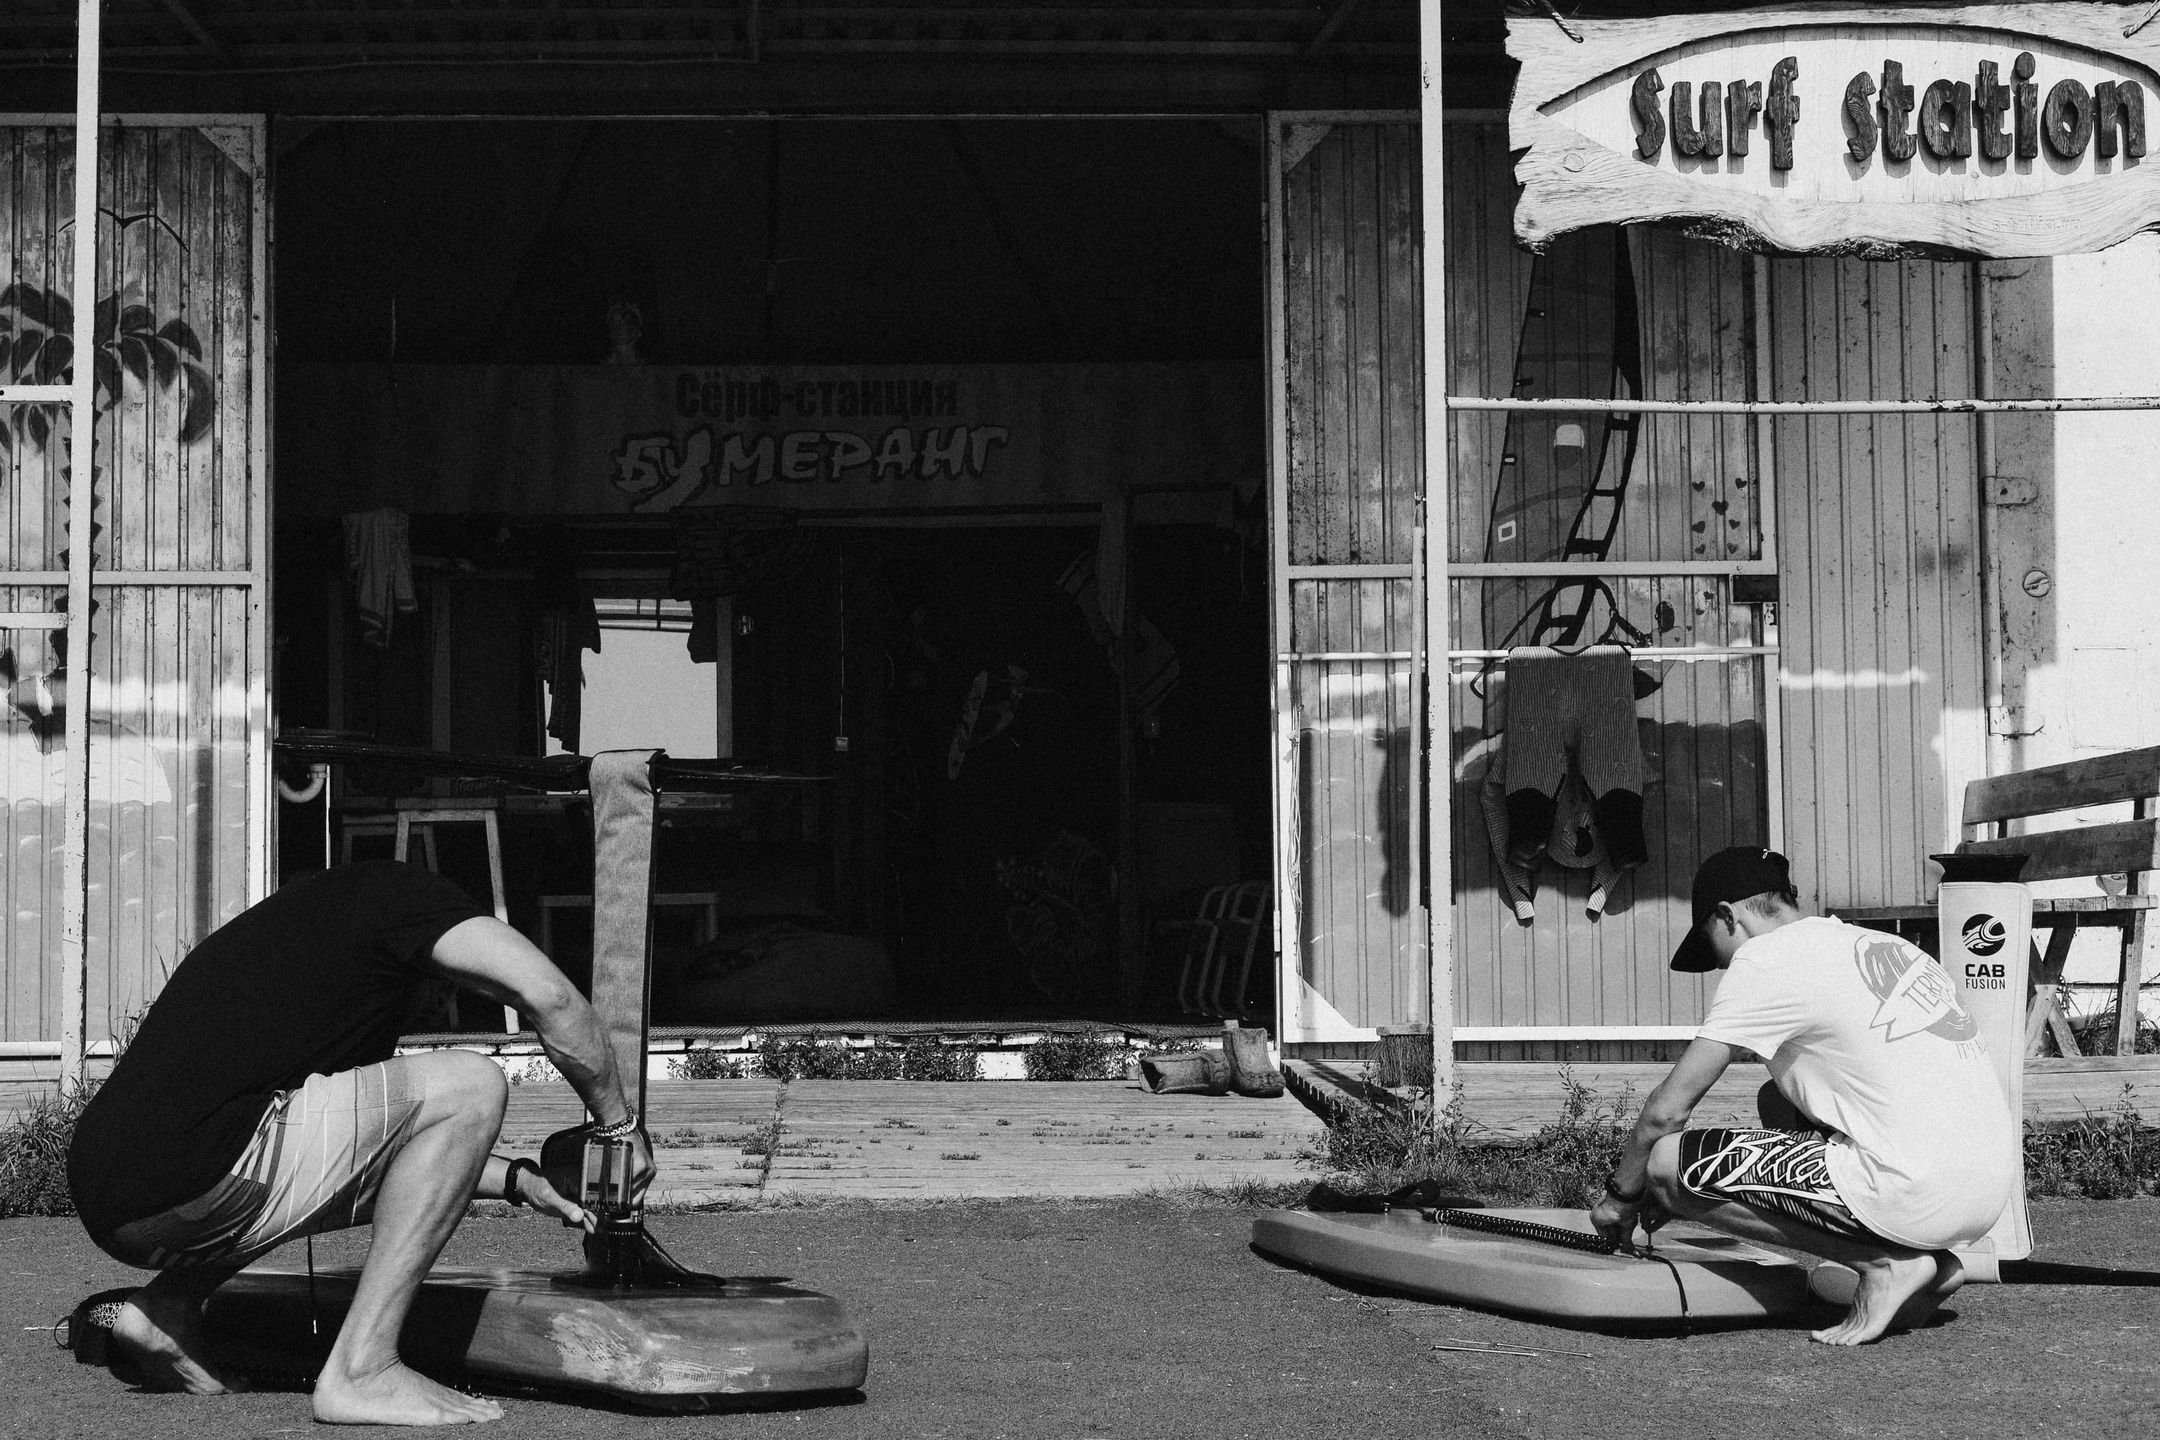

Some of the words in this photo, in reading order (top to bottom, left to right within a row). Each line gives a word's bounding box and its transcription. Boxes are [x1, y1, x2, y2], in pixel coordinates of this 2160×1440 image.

[675, 372, 958, 422] Сёрф-станция
[612, 423, 1011, 513] БУМЕРАНГ
[1965, 963, 2006, 978] CAB
[1965, 978, 2006, 990] FUSION
